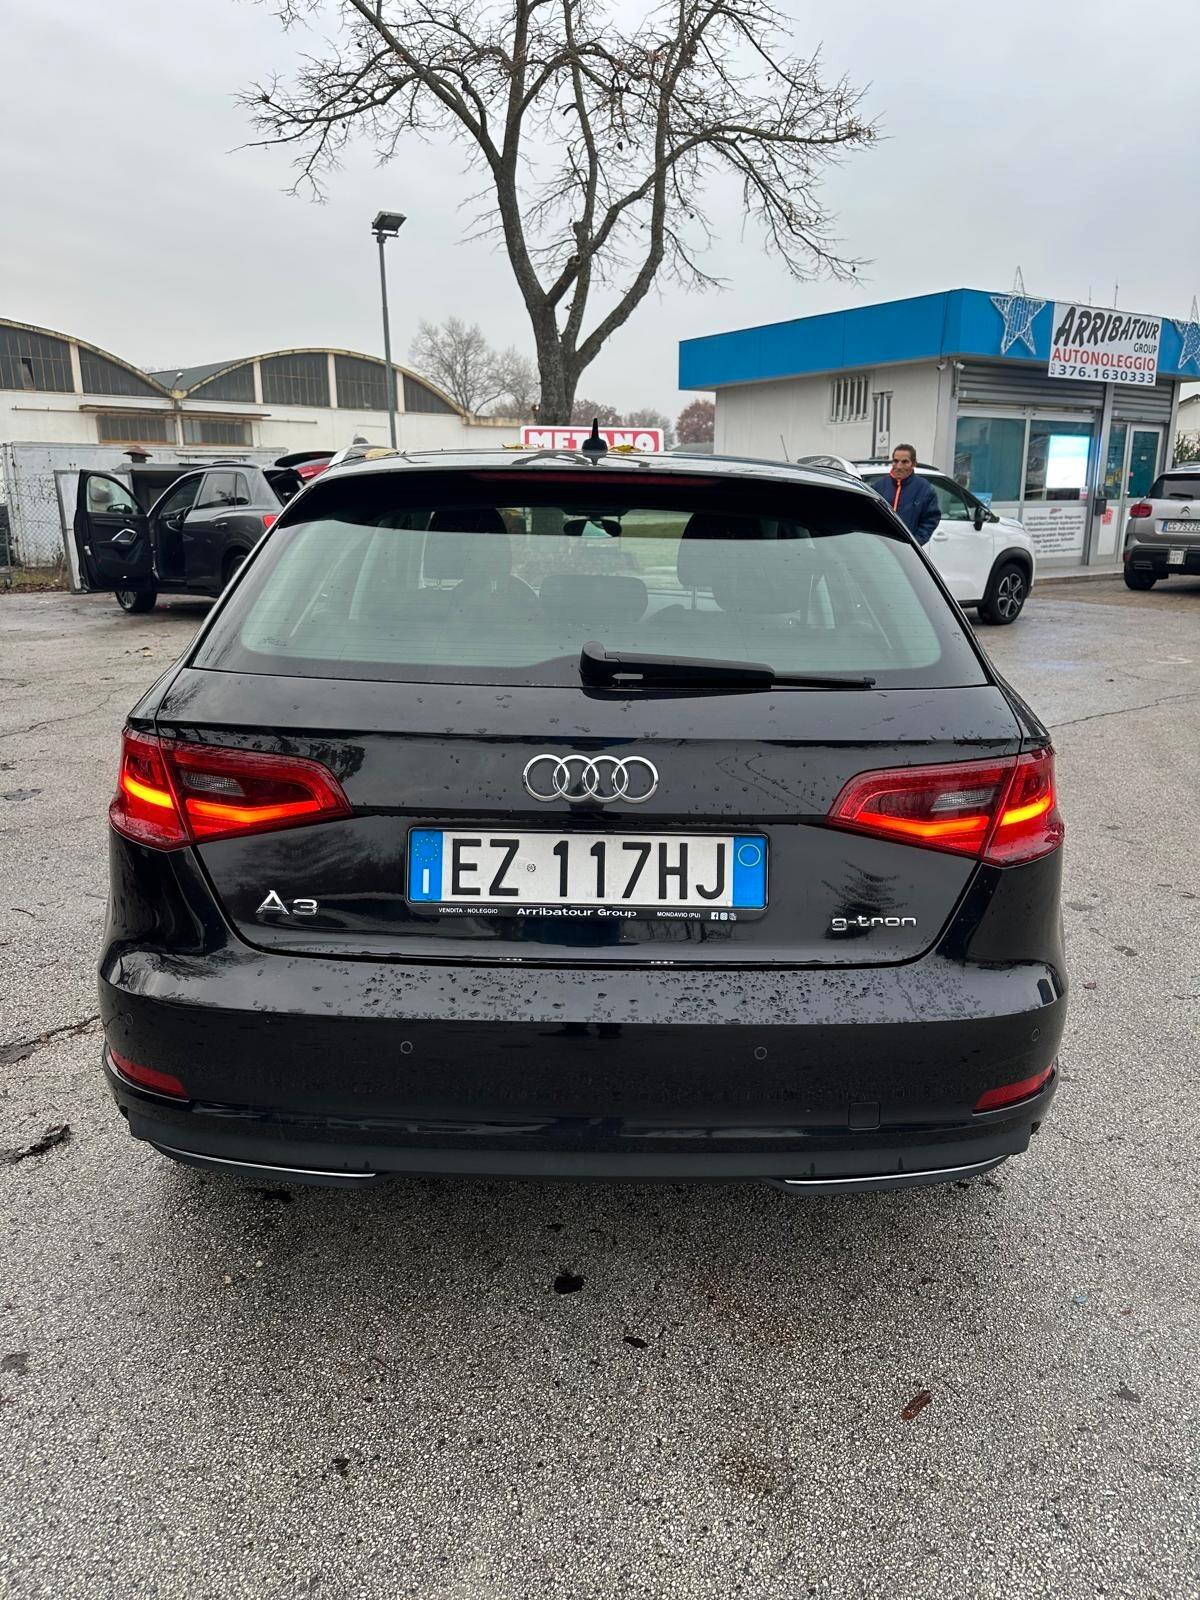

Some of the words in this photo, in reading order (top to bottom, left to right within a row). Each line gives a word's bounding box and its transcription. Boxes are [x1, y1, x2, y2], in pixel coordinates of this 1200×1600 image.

[1053, 306, 1159, 347] ARRIBATOUR
[1133, 342, 1157, 354] GROUP
[1052, 347, 1155, 371] AUTONOLEGGIO
[1058, 364, 1154, 384] 376.1630333
[452, 838, 520, 897] EZ
[553, 840, 726, 900] 117HJ
[255, 889, 318, 916] A3
[517, 907, 594, 916] Arribatour
[597, 908, 637, 918] Group
[656, 910, 688, 918] MONDAVIO
[689, 911, 701, 919] (PU)
[831, 915, 917, 931] g-tron
